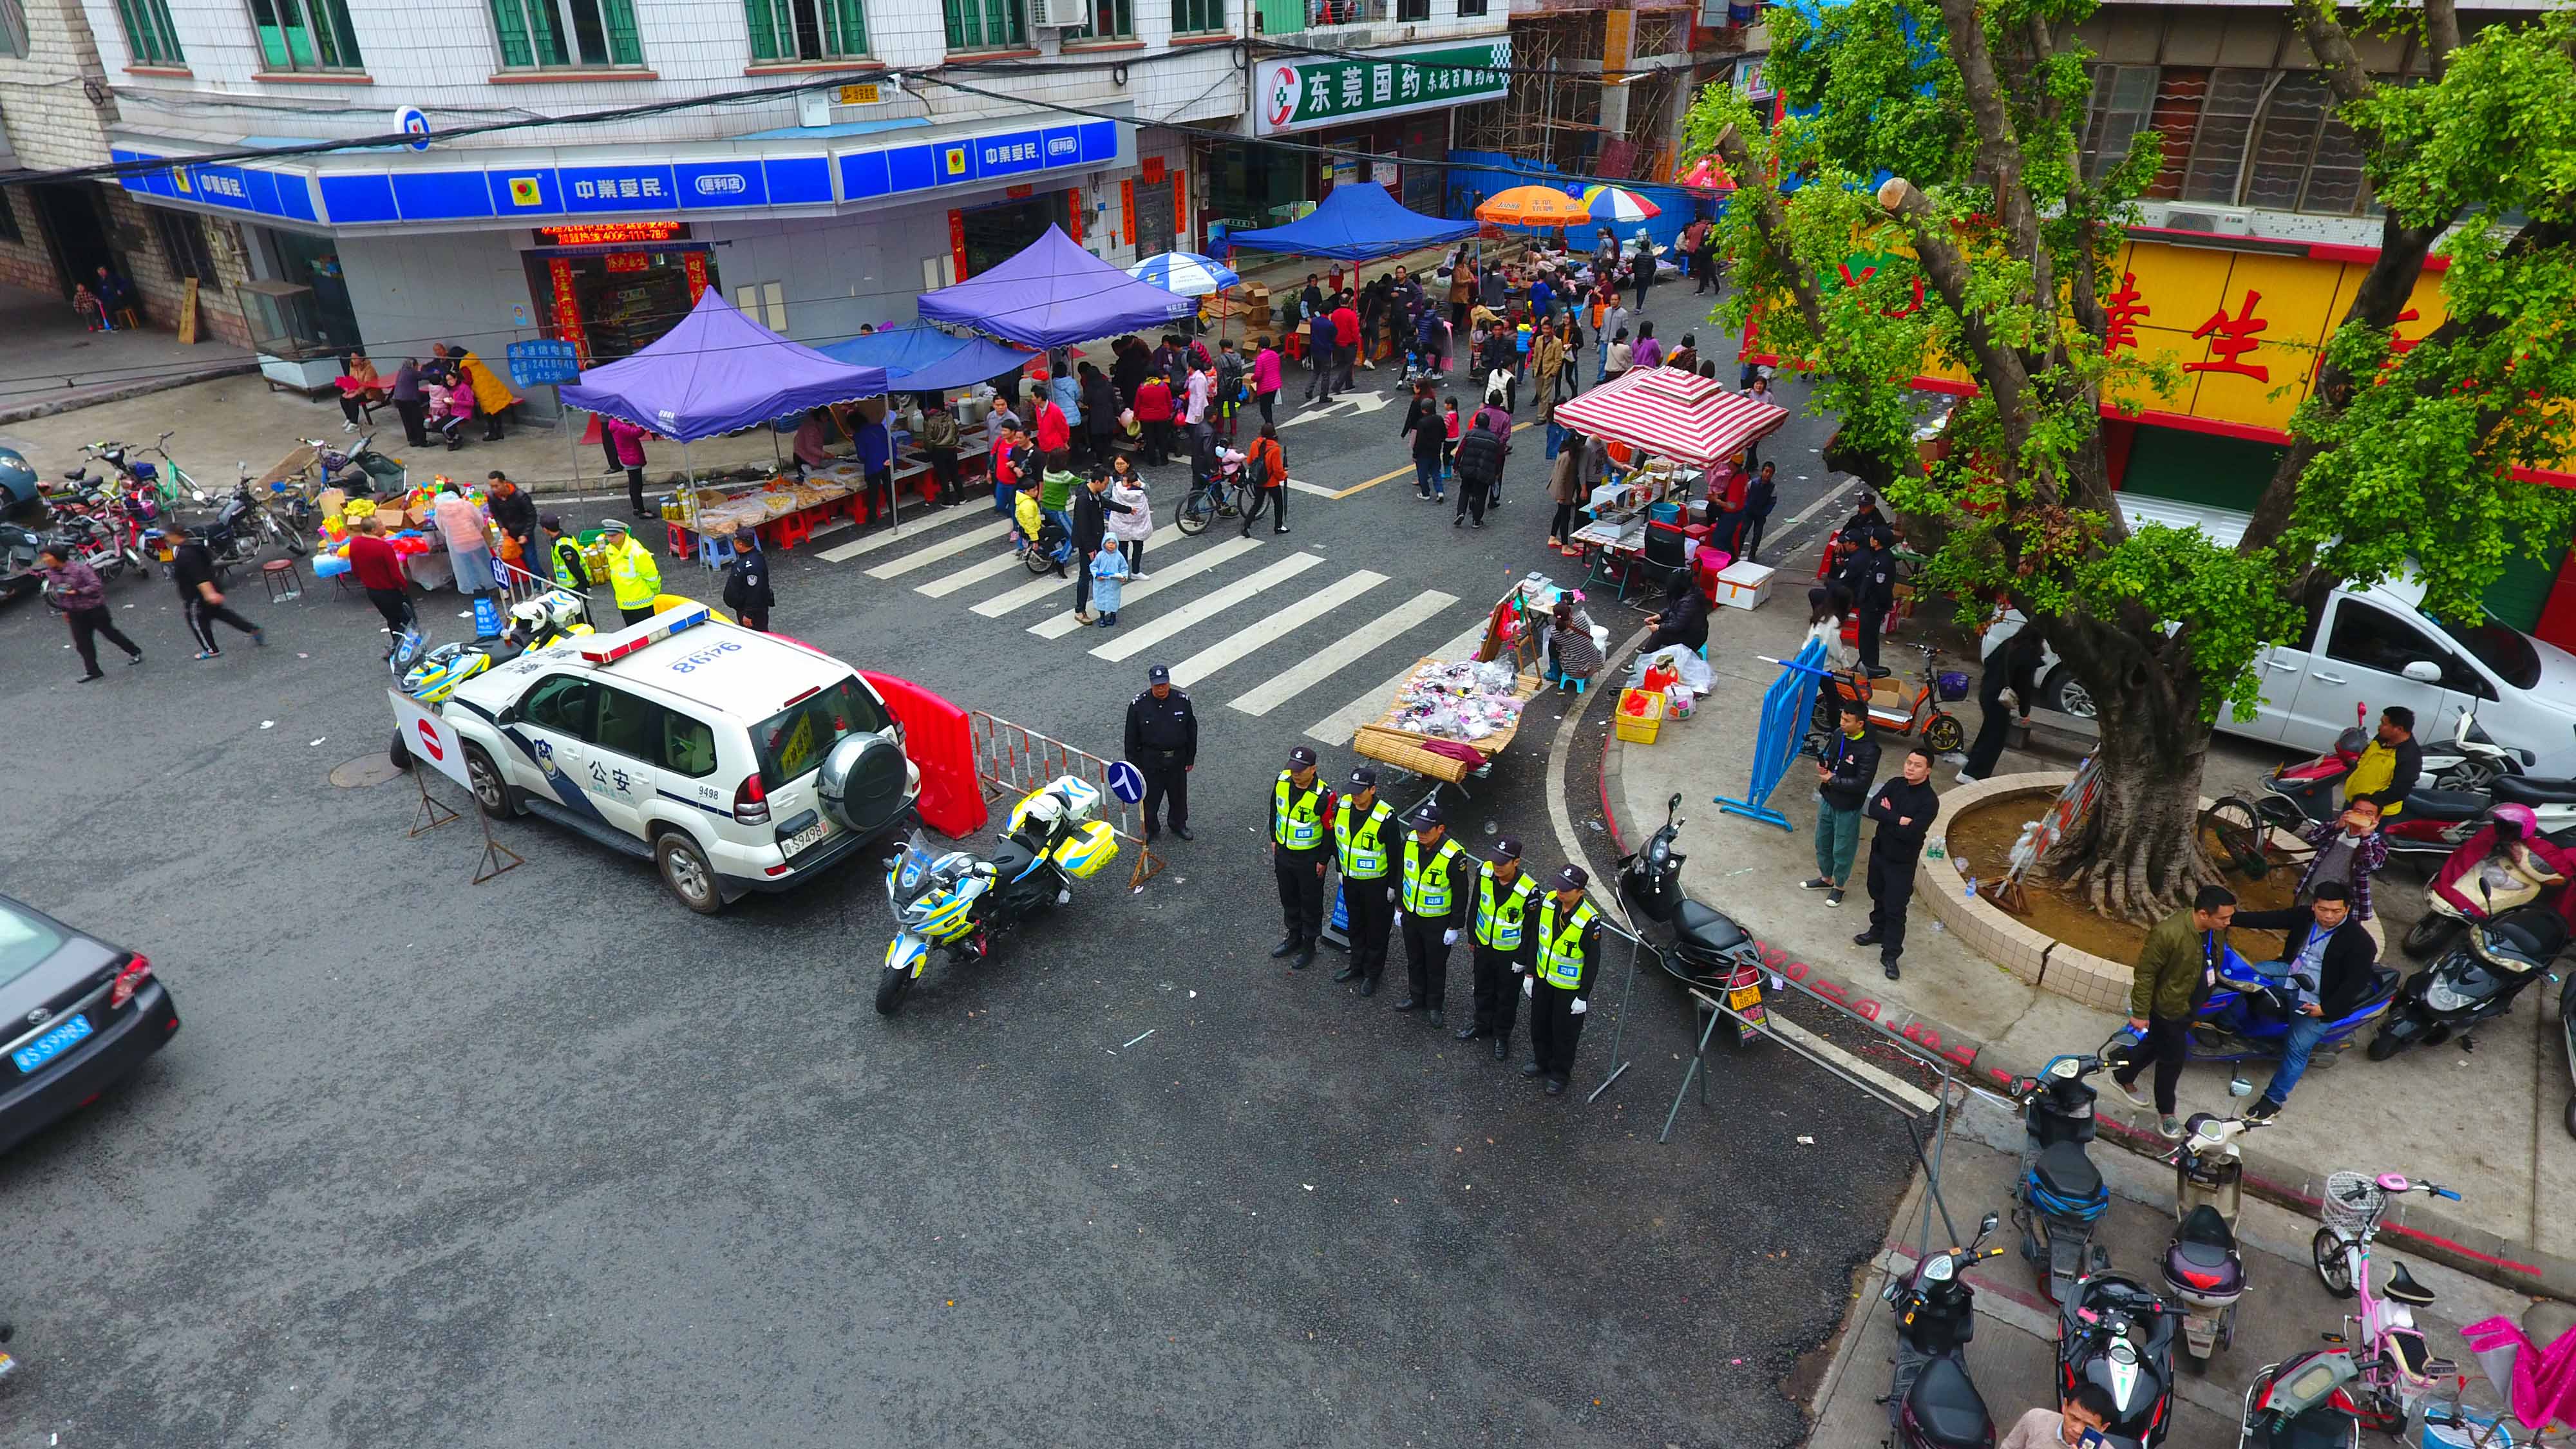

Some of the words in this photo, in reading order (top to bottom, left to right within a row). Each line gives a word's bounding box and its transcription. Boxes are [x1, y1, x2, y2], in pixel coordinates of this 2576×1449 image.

[1309, 63, 1420, 112] 东莞国药
[699, 176, 741, 191] 便利店
[589, 761, 631, 795] 公安
[699, 786, 719, 800] 9498
